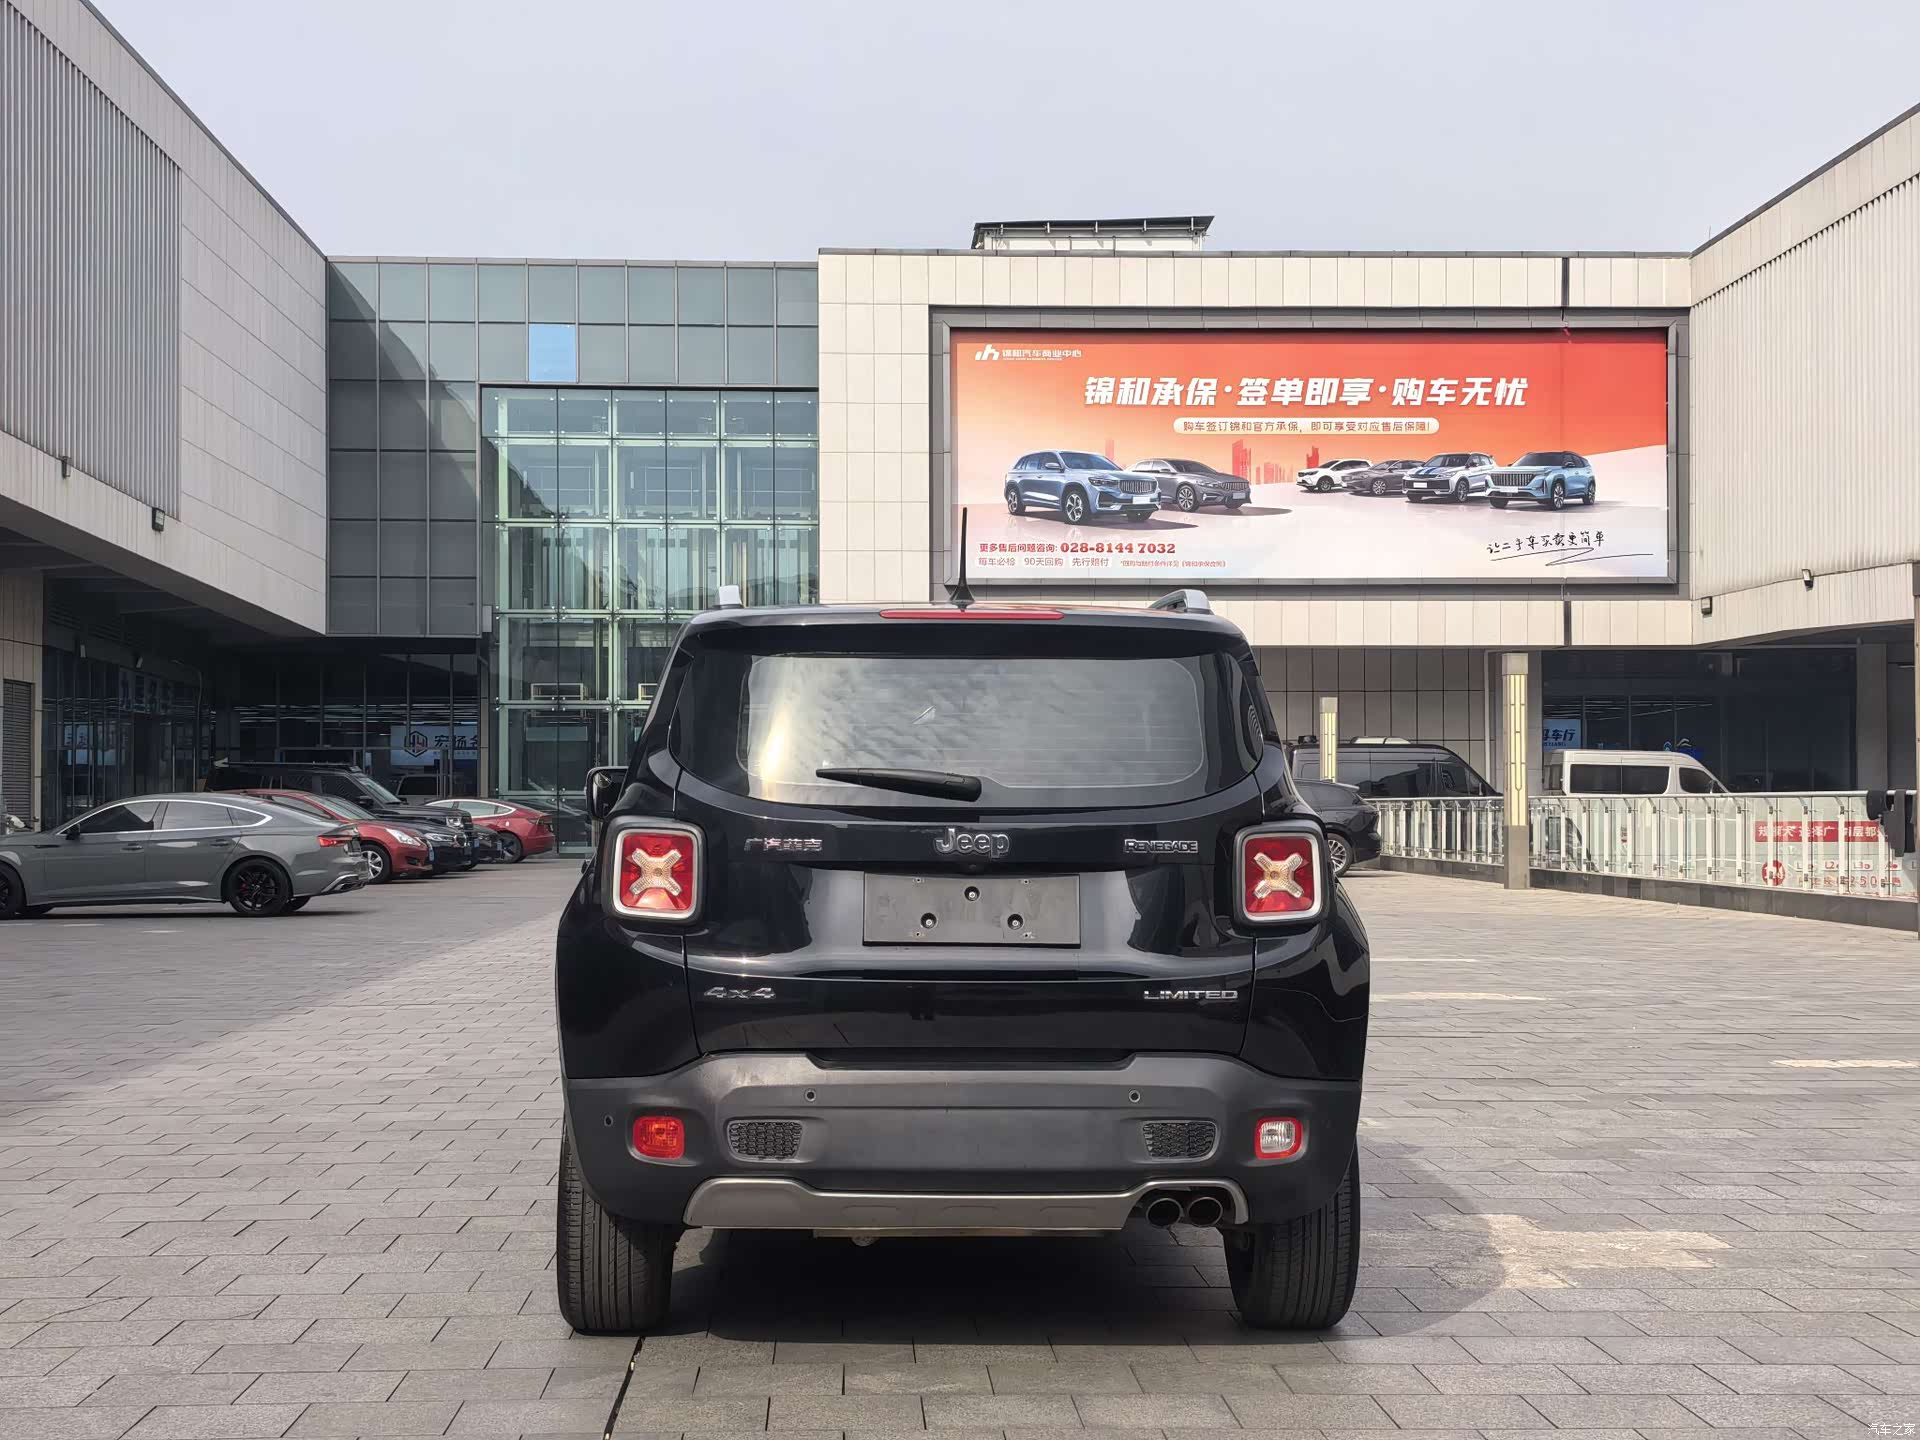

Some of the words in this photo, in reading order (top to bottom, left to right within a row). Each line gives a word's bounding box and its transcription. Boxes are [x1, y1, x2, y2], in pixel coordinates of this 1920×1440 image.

[1084, 376, 1529, 407] 锦和承保·签单即享·购车无忧
[1060, 542, 1134, 553] 028-8144
[1138, 543, 1176, 554] 7032
[935, 828, 1010, 858] Jeep
[1123, 838, 1198, 854] RENEGADE
[1143, 990, 1238, 1000] LIMITED
